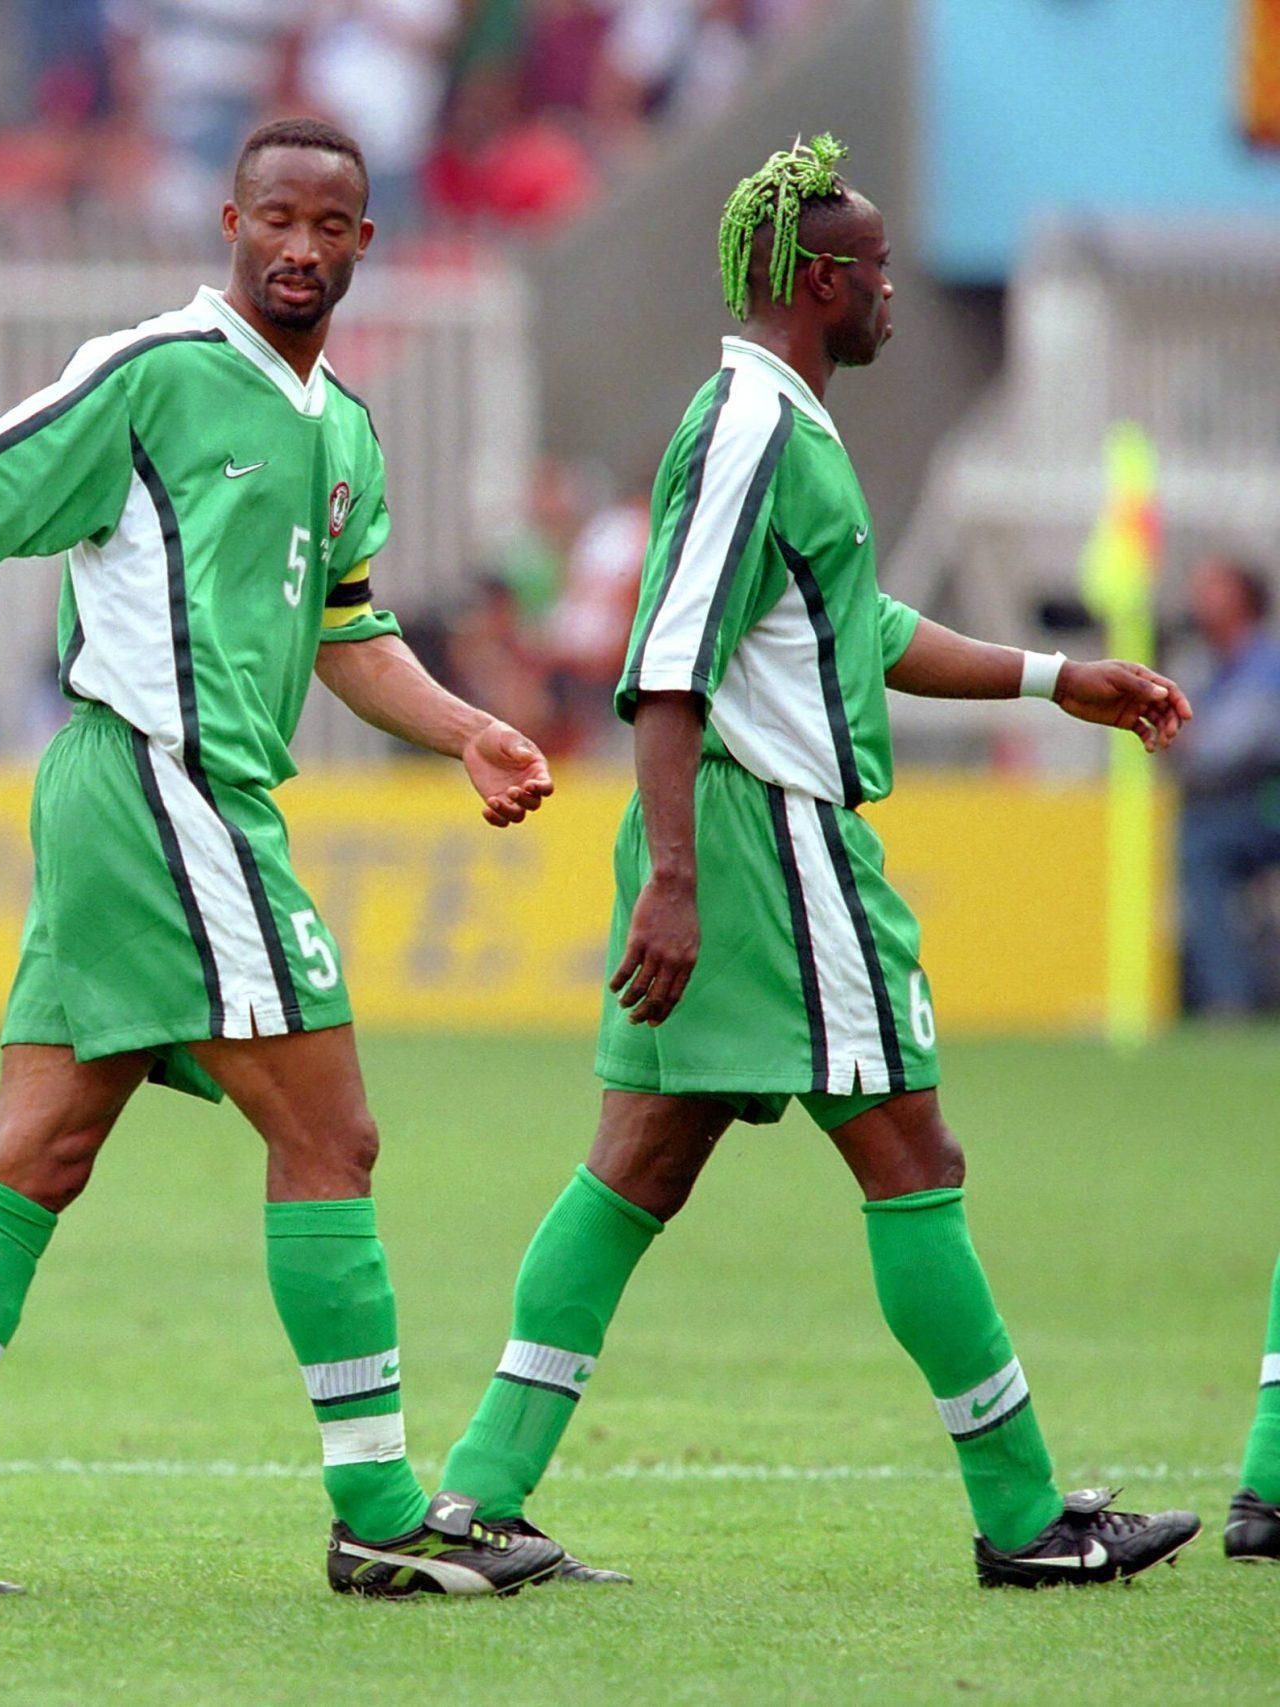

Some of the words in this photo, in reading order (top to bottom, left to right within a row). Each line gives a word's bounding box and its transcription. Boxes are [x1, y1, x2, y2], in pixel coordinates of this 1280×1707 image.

[283, 524, 311, 609] 5
[289, 908, 338, 990] 5
[909, 968, 936, 1049] 6
